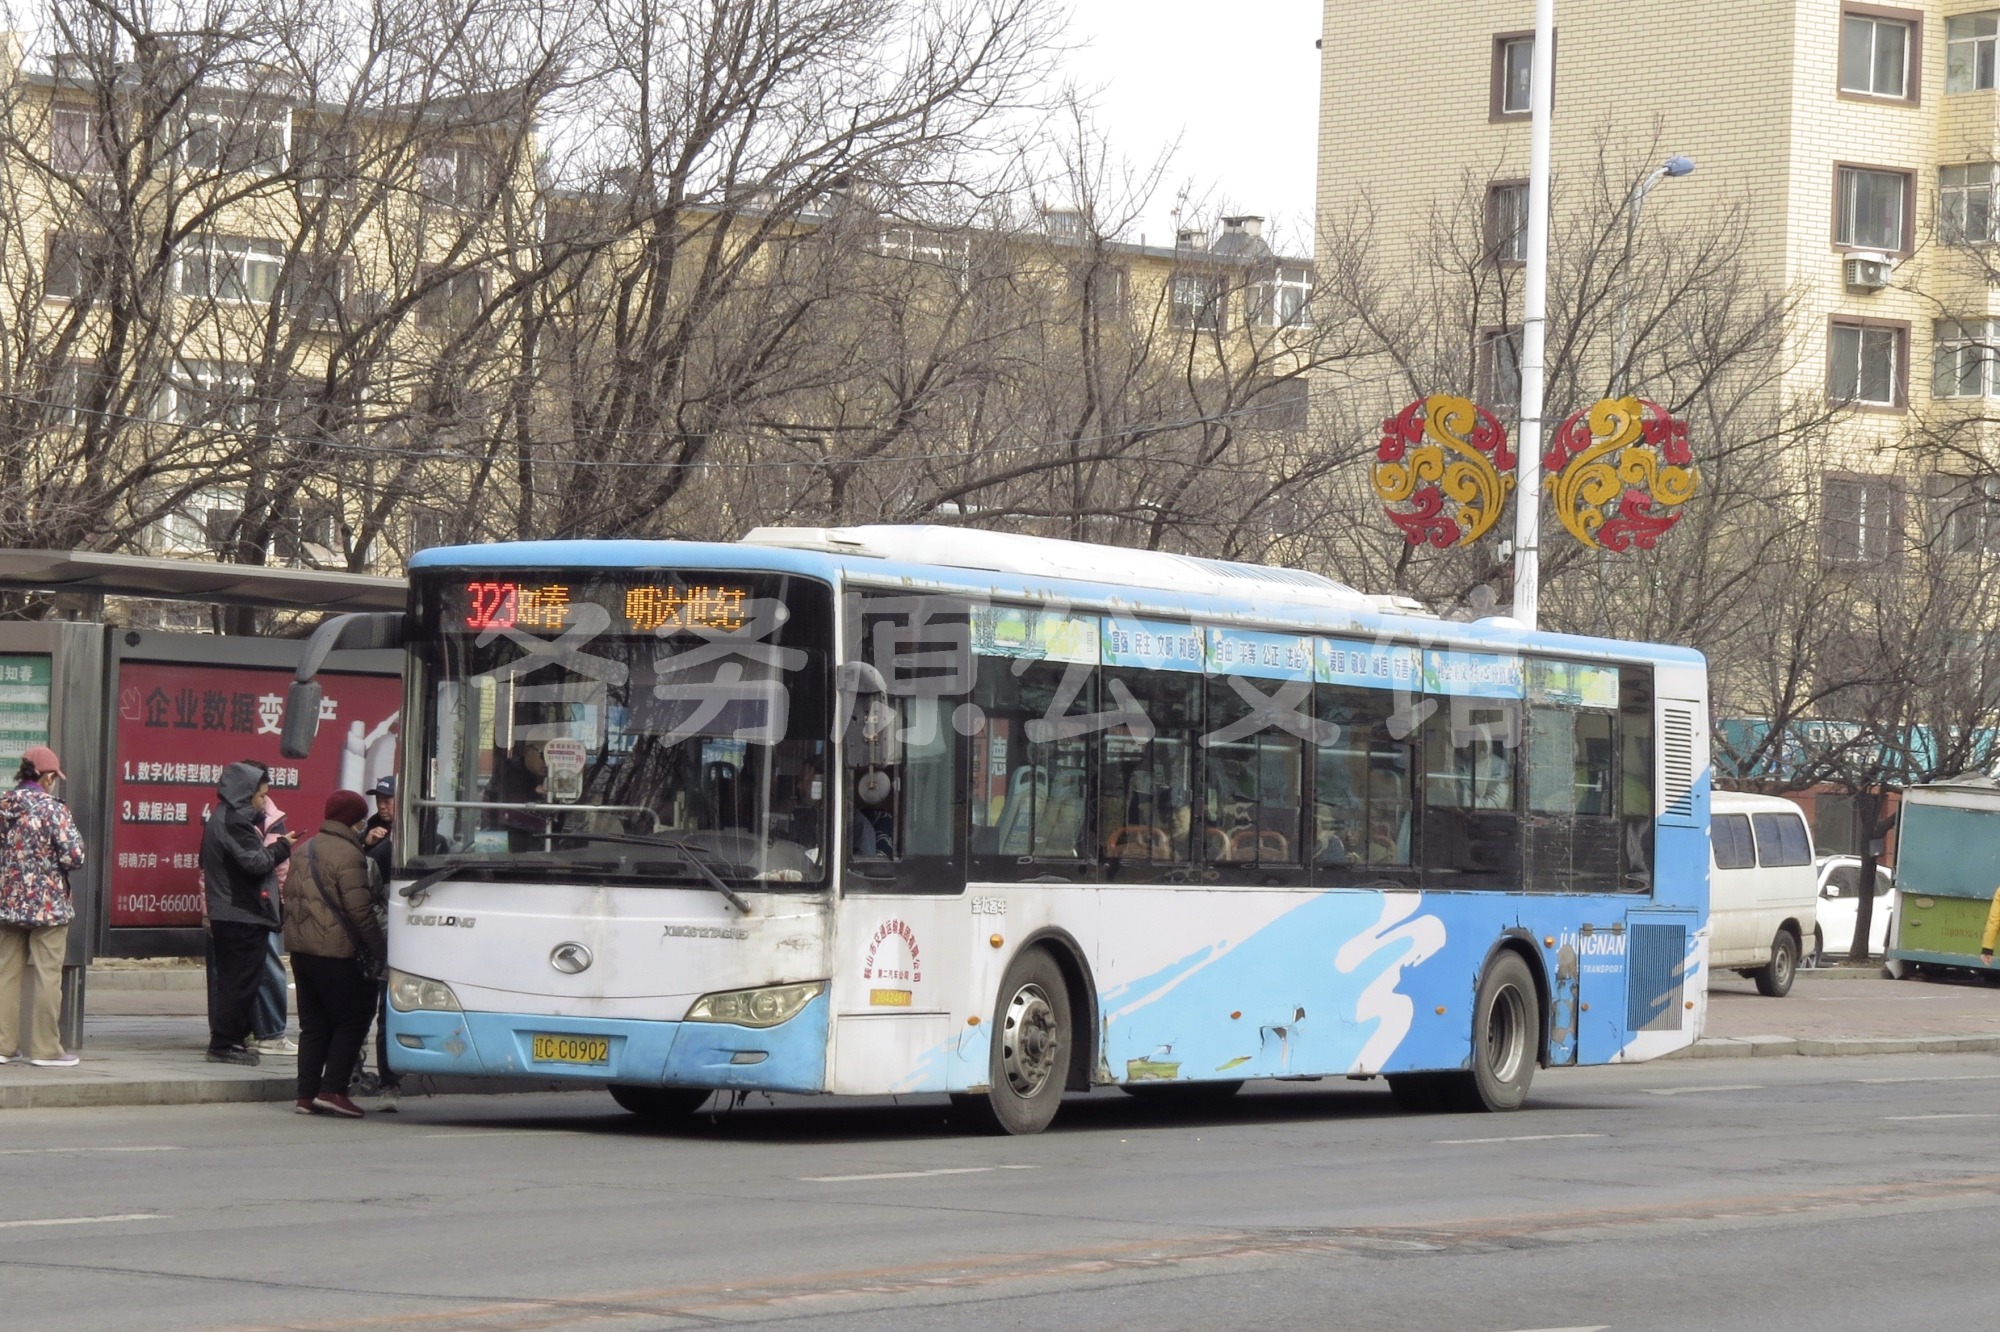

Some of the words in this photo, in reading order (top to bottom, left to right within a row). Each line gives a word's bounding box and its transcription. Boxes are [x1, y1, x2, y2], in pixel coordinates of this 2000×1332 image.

[466, 582, 516, 629] 323
[625, 585, 746, 630] 明达世纪
[1112, 631, 1129, 654] 富强
[1135, 633, 1151, 655] 民主
[1157, 635, 1173, 658] 文明
[1179, 637, 1196, 660] 和谐
[1216, 640, 1233, 663] 自由
[1239, 642, 1256, 665] 平等
[1263, 644, 1279, 667] 公正
[1285, 647, 1302, 669] 法治
[1329, 649, 1346, 673] 爱国
[1351, 652, 1367, 675] 敬业
[1372, 654, 1388, 677] 诚信
[1393, 656, 1409, 680] 友善
[145, 686, 338, 737] 企业数据变产
[118, 853, 157, 868] 明确方向
[406, 915, 437, 926] KING
[437, 916, 476, 928] LONG
[863, 919, 921, 983] 鞍山市交通运输集团有限公司
[878, 969, 910, 980] 第二汽车公司
[1583, 964, 1623, 974] TRANSPORT
